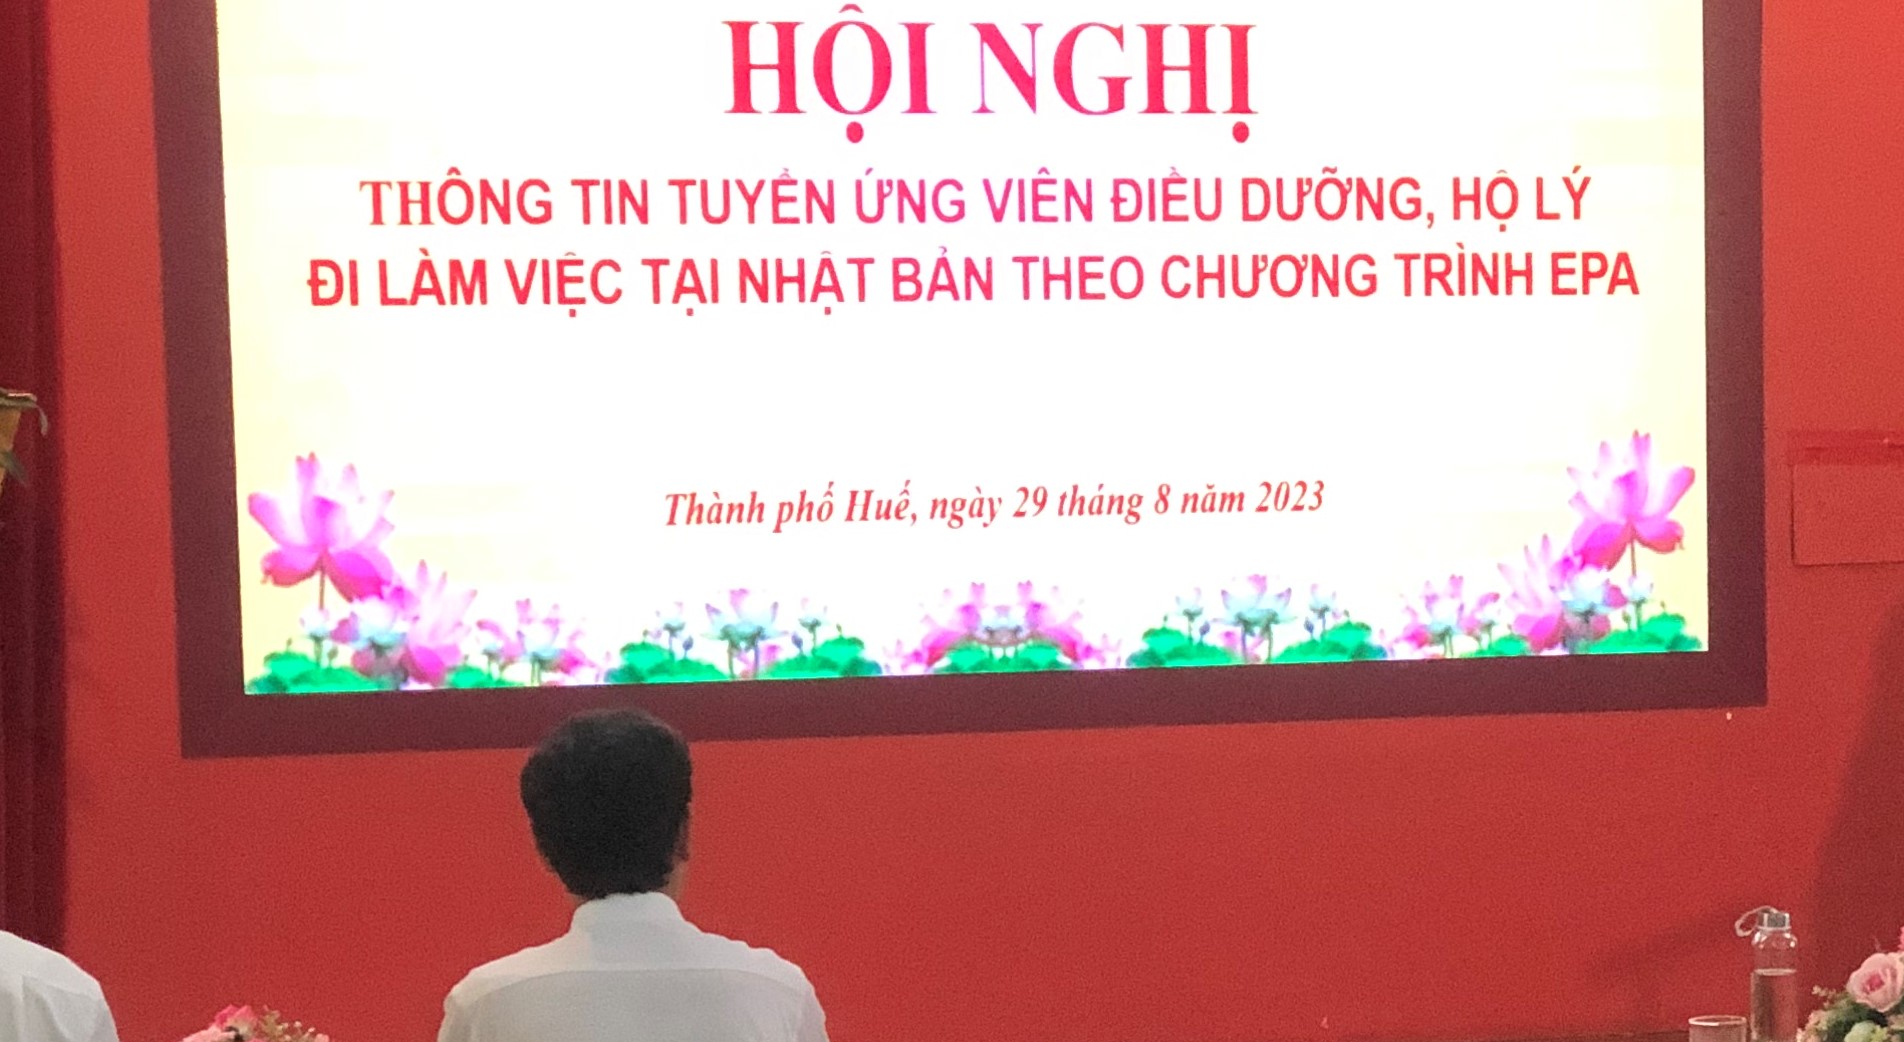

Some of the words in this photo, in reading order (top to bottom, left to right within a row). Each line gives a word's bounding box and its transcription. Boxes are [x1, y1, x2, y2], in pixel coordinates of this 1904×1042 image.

[725, 4, 935, 145] HỘI
[973, 22, 1256, 145] NGHỊ
[359, 167, 554, 227] THÔNG
[571, 179, 651, 227] TIN
[855, 168, 967, 226] ỨNG
[981, 167, 1095, 225] VIÊN
[1110, 166, 1224, 224] ĐIỀU
[1242, 167, 1436, 229] DƯỠNG,
[1453, 169, 1521, 234] HỘ
[1536, 165, 1593, 222] LÝ
[306, 259, 361, 308] ĐI
[378, 247, 489, 308] LÀM
[505, 251, 624, 319] VIỆC
[641, 258, 721, 318] TẠI
[739, 250, 877, 317] NHẬT
[892, 246, 995, 304] BẢN
[1012, 256, 1146, 302] THEO
[1161, 253, 1379, 301] CHƯƠNG
[1394, 242, 1535, 299] TRÌNH
[1551, 251, 1642, 297] EPA
[666, 489, 765, 525] Thành
[772, 480, 834, 533] phố
[844, 479, 917, 521] Huế,
[928, 486, 1003, 528] ngày
[1012, 485, 1049, 517] 29
[1056, 483, 1144, 524] tháng
[1152, 483, 1171, 514] 8
[1179, 483, 1246, 512] năm
[1254, 479, 1325, 512] 2023
